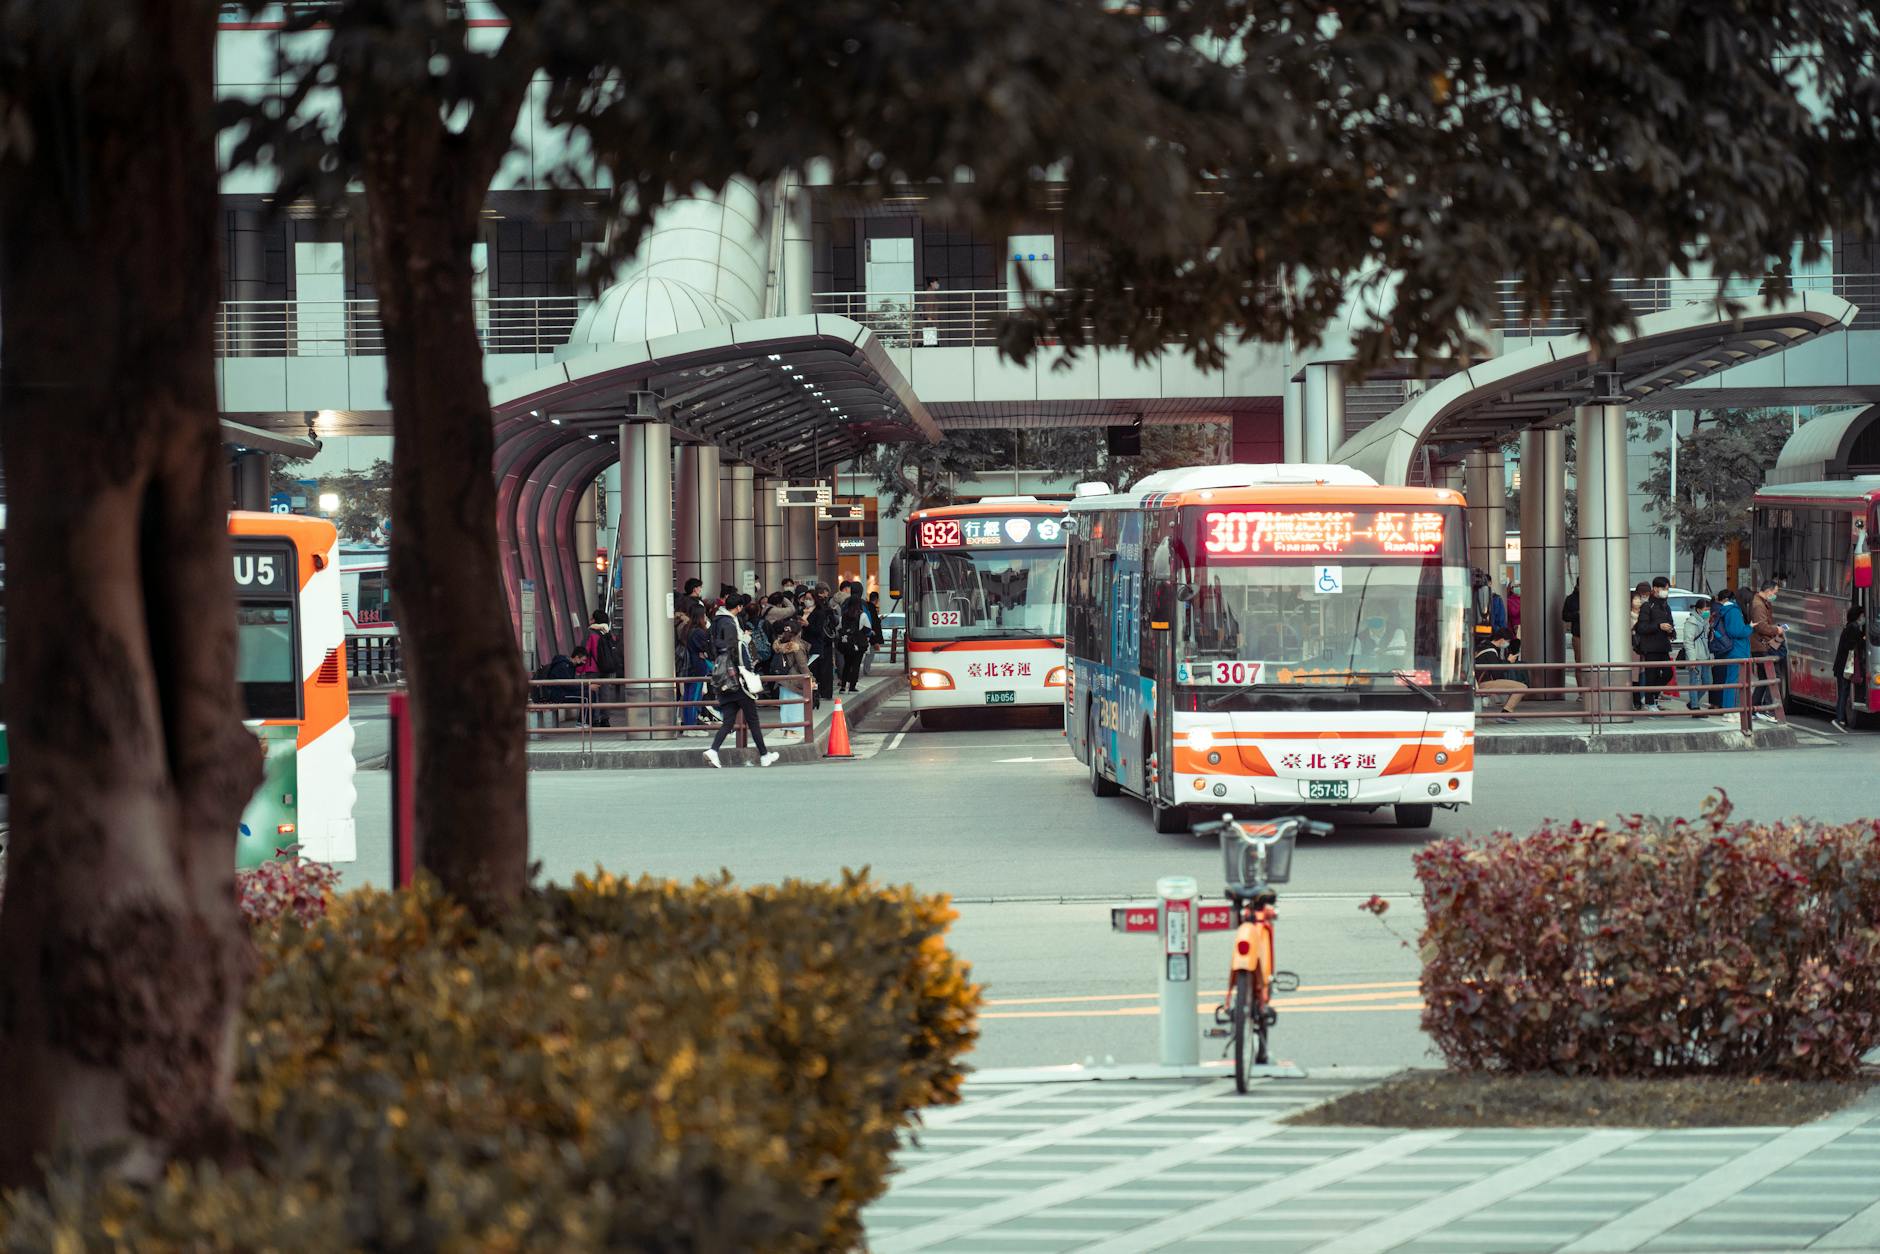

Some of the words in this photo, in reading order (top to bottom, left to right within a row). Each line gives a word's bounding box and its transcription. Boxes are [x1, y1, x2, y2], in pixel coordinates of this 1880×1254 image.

[923, 521, 958, 544] 932
[964, 521, 1000, 537] 行經
[1205, 512, 1262, 552] 307
[966, 536, 1001, 545] EXPRESS
[233, 556, 275, 586] U5
[931, 612, 959, 625] 932
[967, 661, 1032, 678] 臺北客運
[1216, 662, 1262, 685] 307
[986, 692, 1015, 703] FAD-056
[1280, 752, 1377, 770] 臺北客運
[1310, 783, 1348, 799] 257-U5
